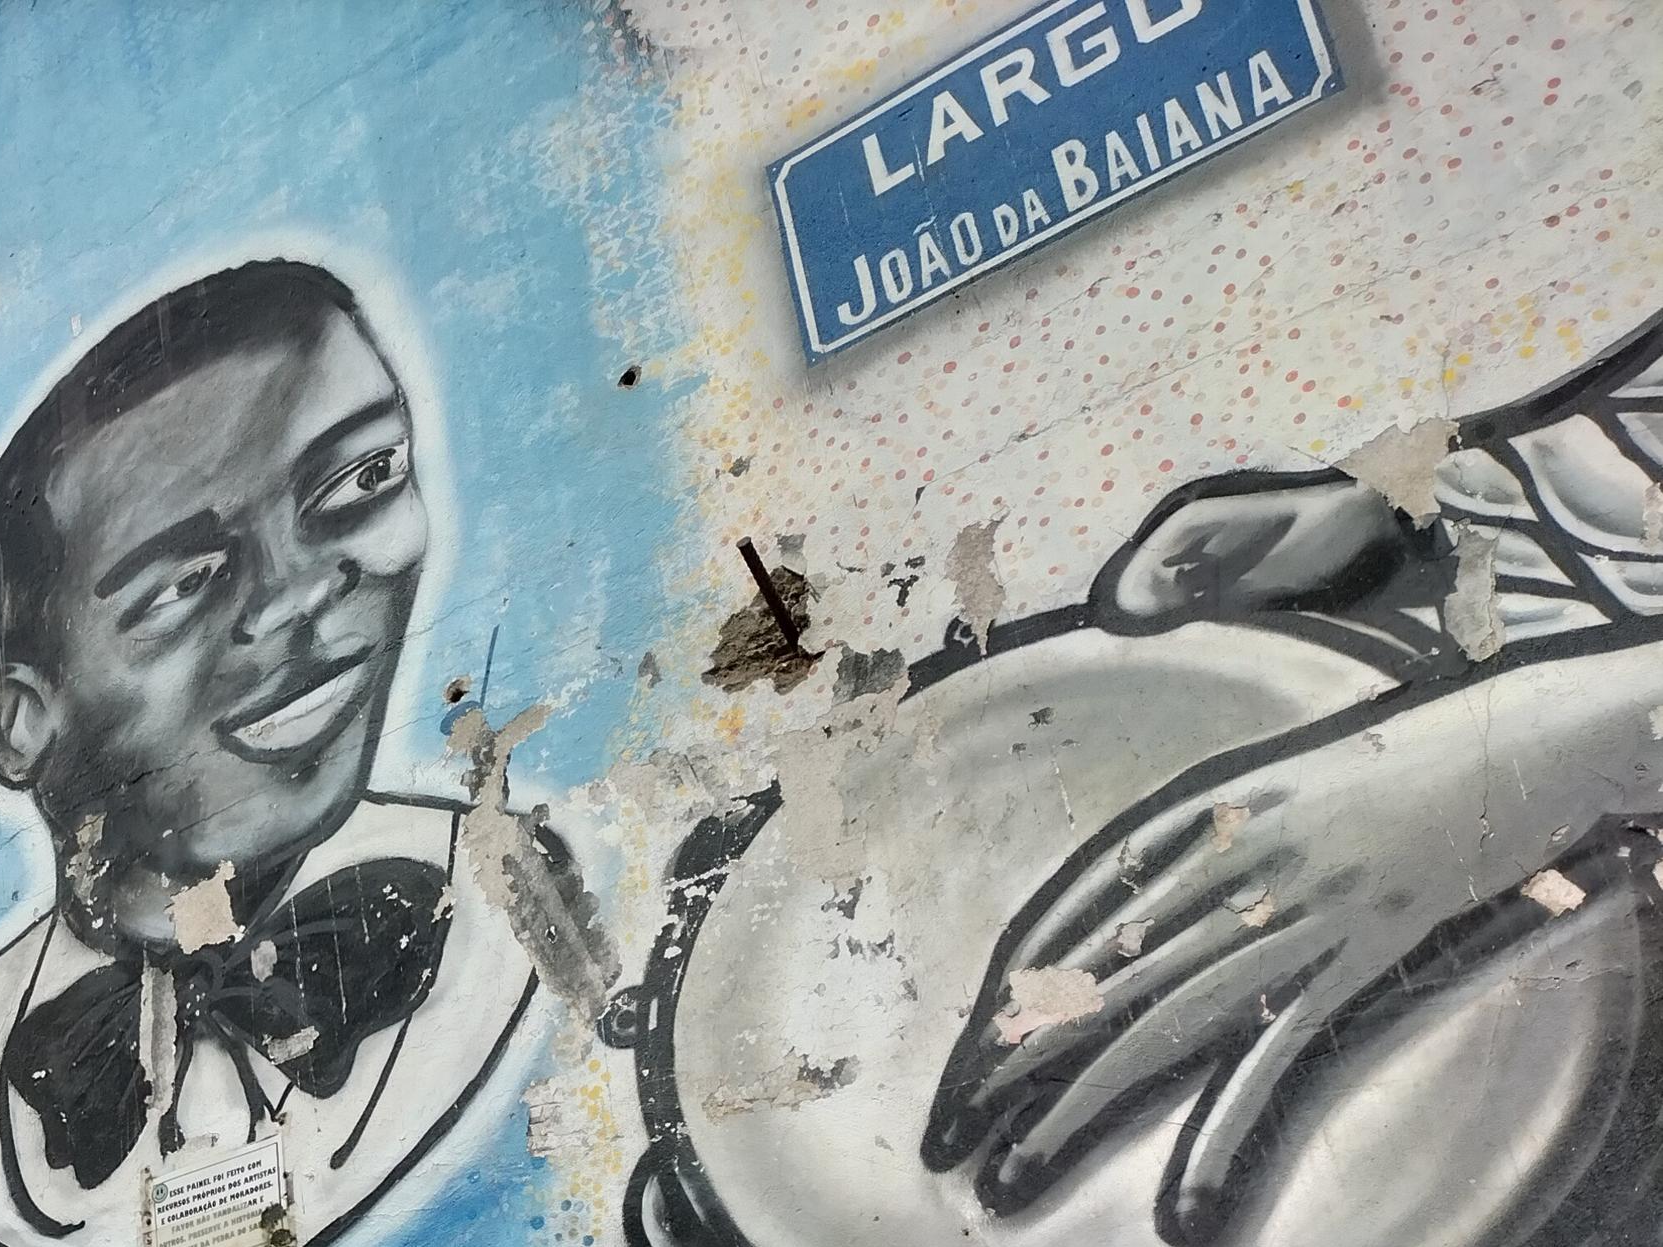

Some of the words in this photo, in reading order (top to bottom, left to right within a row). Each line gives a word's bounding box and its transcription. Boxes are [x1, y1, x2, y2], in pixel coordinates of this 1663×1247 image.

[861, 0, 1205, 197] LARGO
[836, 211, 984, 326] JOÃO
[992, 188, 1052, 248] DA
[1051, 50, 1294, 213] BAIANA
[156, 1197, 191, 1214] RECURSOS
[227, 1180, 241, 1192] DOS
[243, 1166, 277, 1185] ARTISTAS
[167, 1200, 217, 1223] COLABORAÇÃO
[218, 1196, 228, 1206] DE
[229, 1180, 274, 1200] MORADORES.
[169, 1186, 185, 1198] ESSE
[186, 1178, 212, 1192] PAINEL
[213, 1173, 224, 1183] FOI
[226, 1166, 245, 1179] FEITO
[247, 1160, 262, 1171] COM
[171, 1220, 195, 1235] FAVOR
